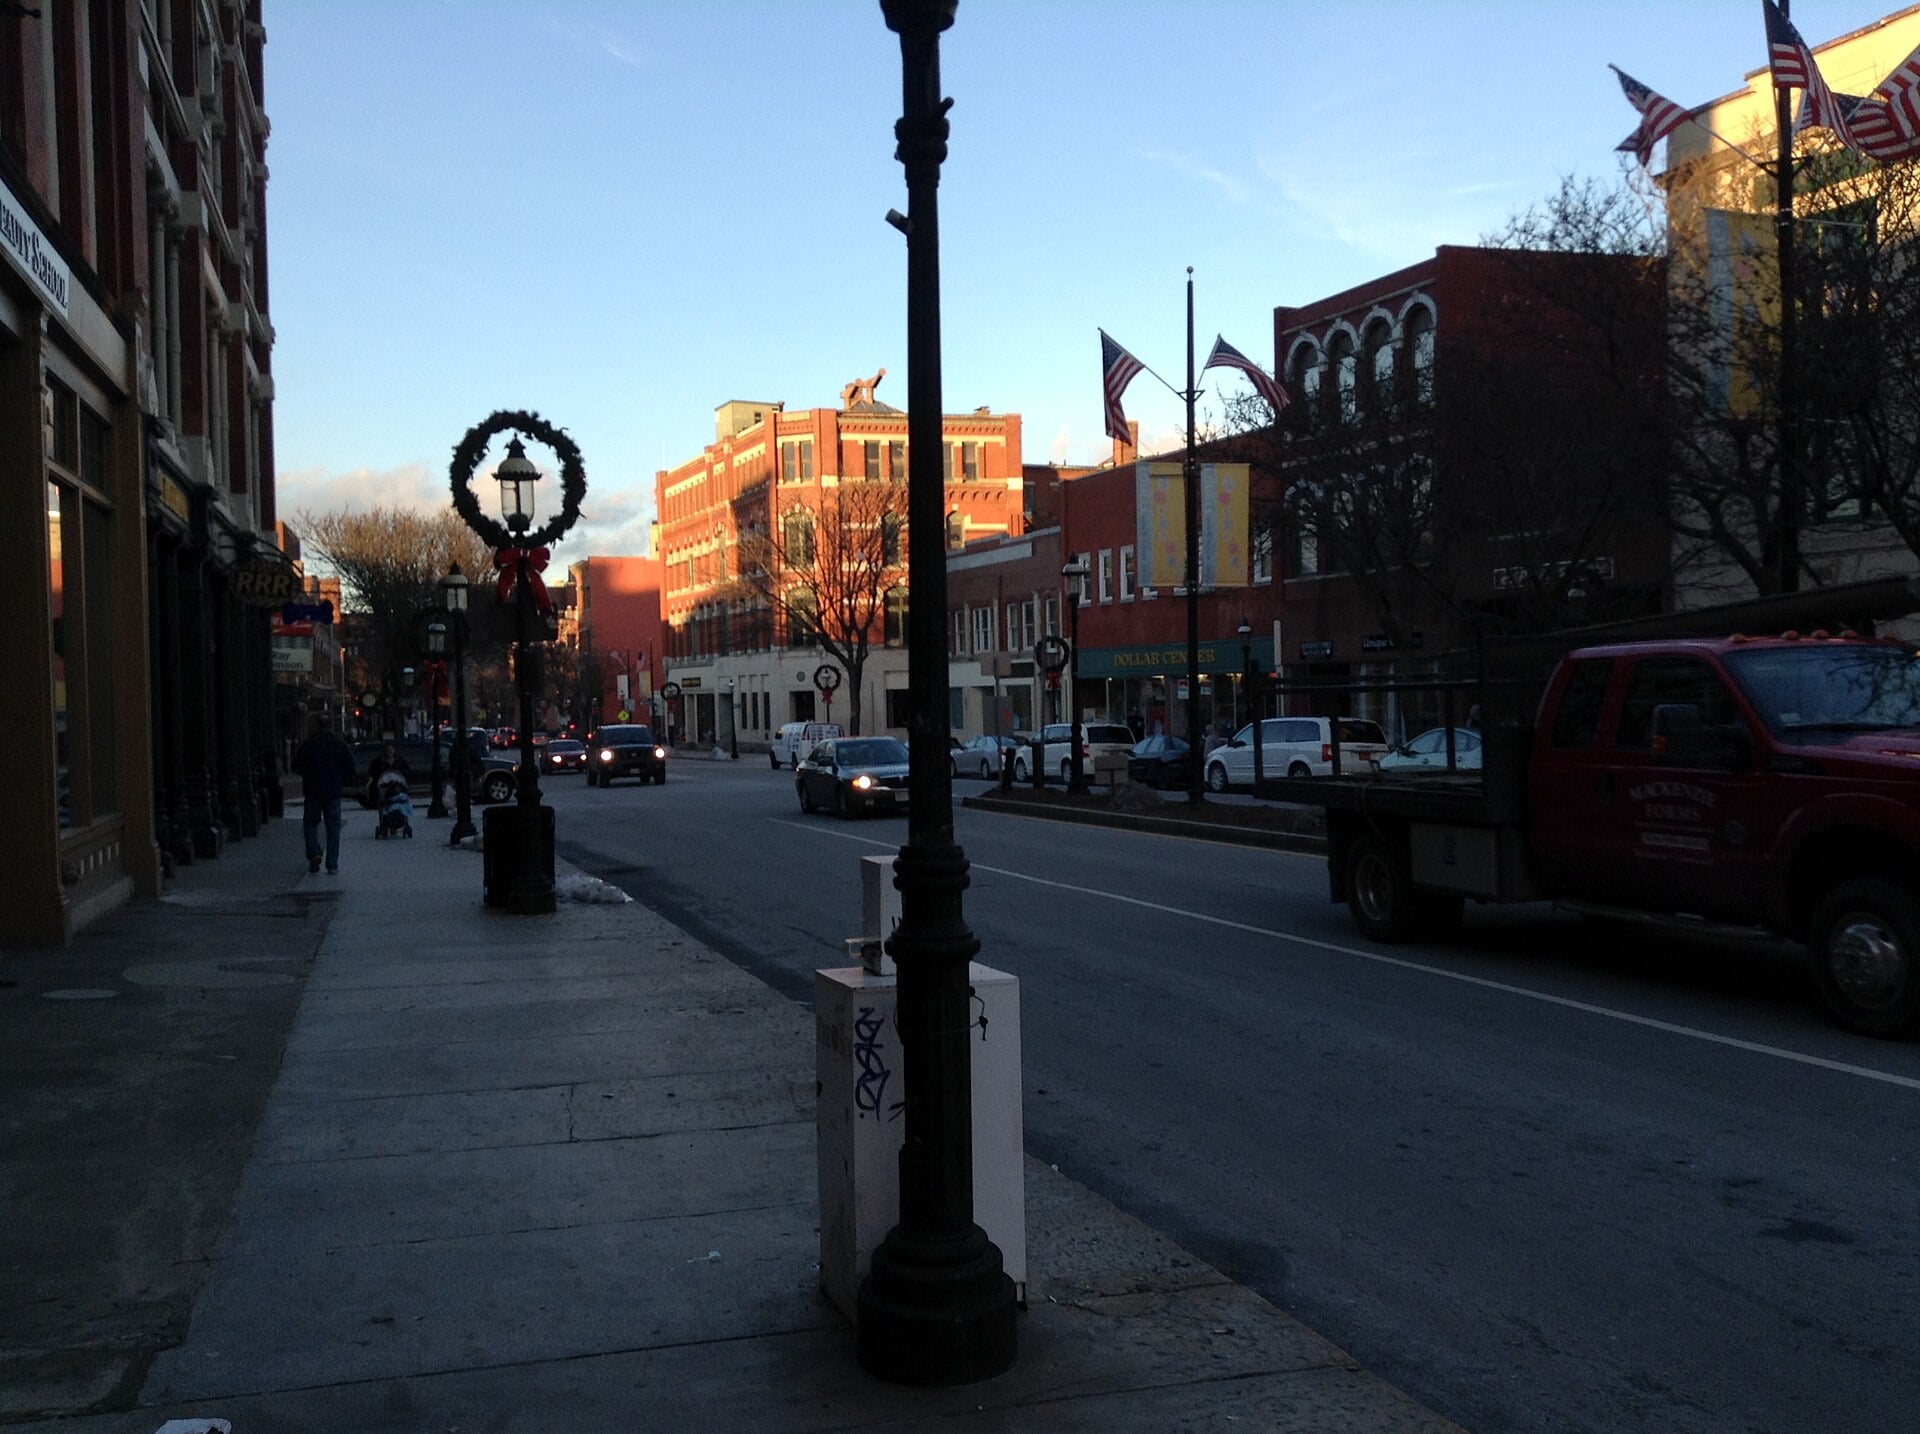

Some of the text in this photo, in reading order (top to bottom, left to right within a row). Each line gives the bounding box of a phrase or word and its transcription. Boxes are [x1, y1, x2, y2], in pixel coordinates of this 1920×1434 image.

[236, 572, 289, 595] RRR
[1113, 649, 1216, 667] DOLLAR CENER
